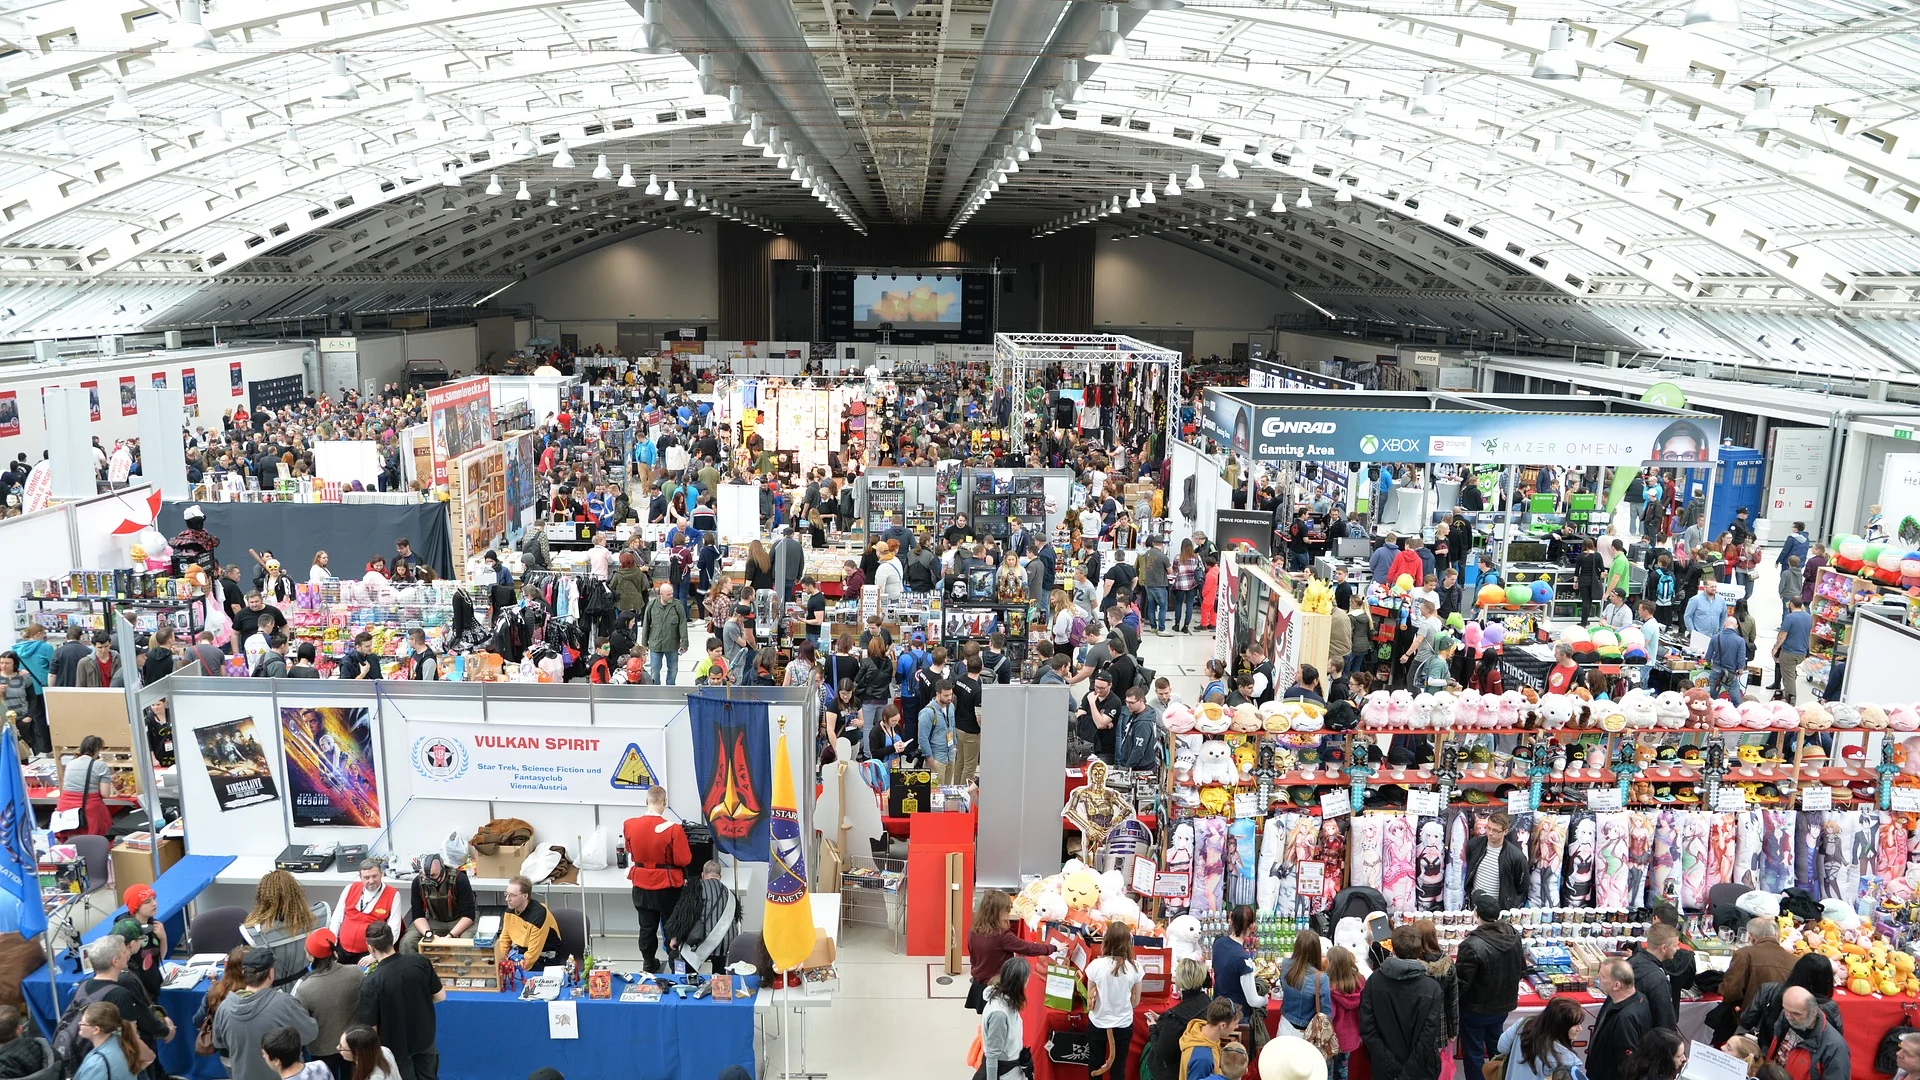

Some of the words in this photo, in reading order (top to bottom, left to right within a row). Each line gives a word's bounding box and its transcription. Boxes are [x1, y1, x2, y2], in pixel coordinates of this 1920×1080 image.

[1417, 354, 1437, 363] PORTIER
[1261, 417, 1337, 437] CONRAD
[1259, 443, 1304, 457] Gaming
[1306, 444, 1335, 456] Area
[1380, 439, 1420, 452] XBOX
[1565, 443, 1618, 454] OMEN
[26, 468, 43, 497] COMICS
[1073, 586, 1085, 602] 72
[474, 735, 540, 749] VULKAN
[545, 737, 600, 751] SPIRIT
[1135, 737, 1144, 747] 72
[477, 762, 496, 771] Star
[497, 763, 519, 772] Trek,
[521, 764, 554, 773] Science
[556, 765, 585, 774] Fiction
[514, 773, 563, 783] Fantasyclub
[510, 782, 568, 791] Vienna/Austria
[296, 796, 329, 805] BEYOND
[767, 889, 804, 903] PLANETS
